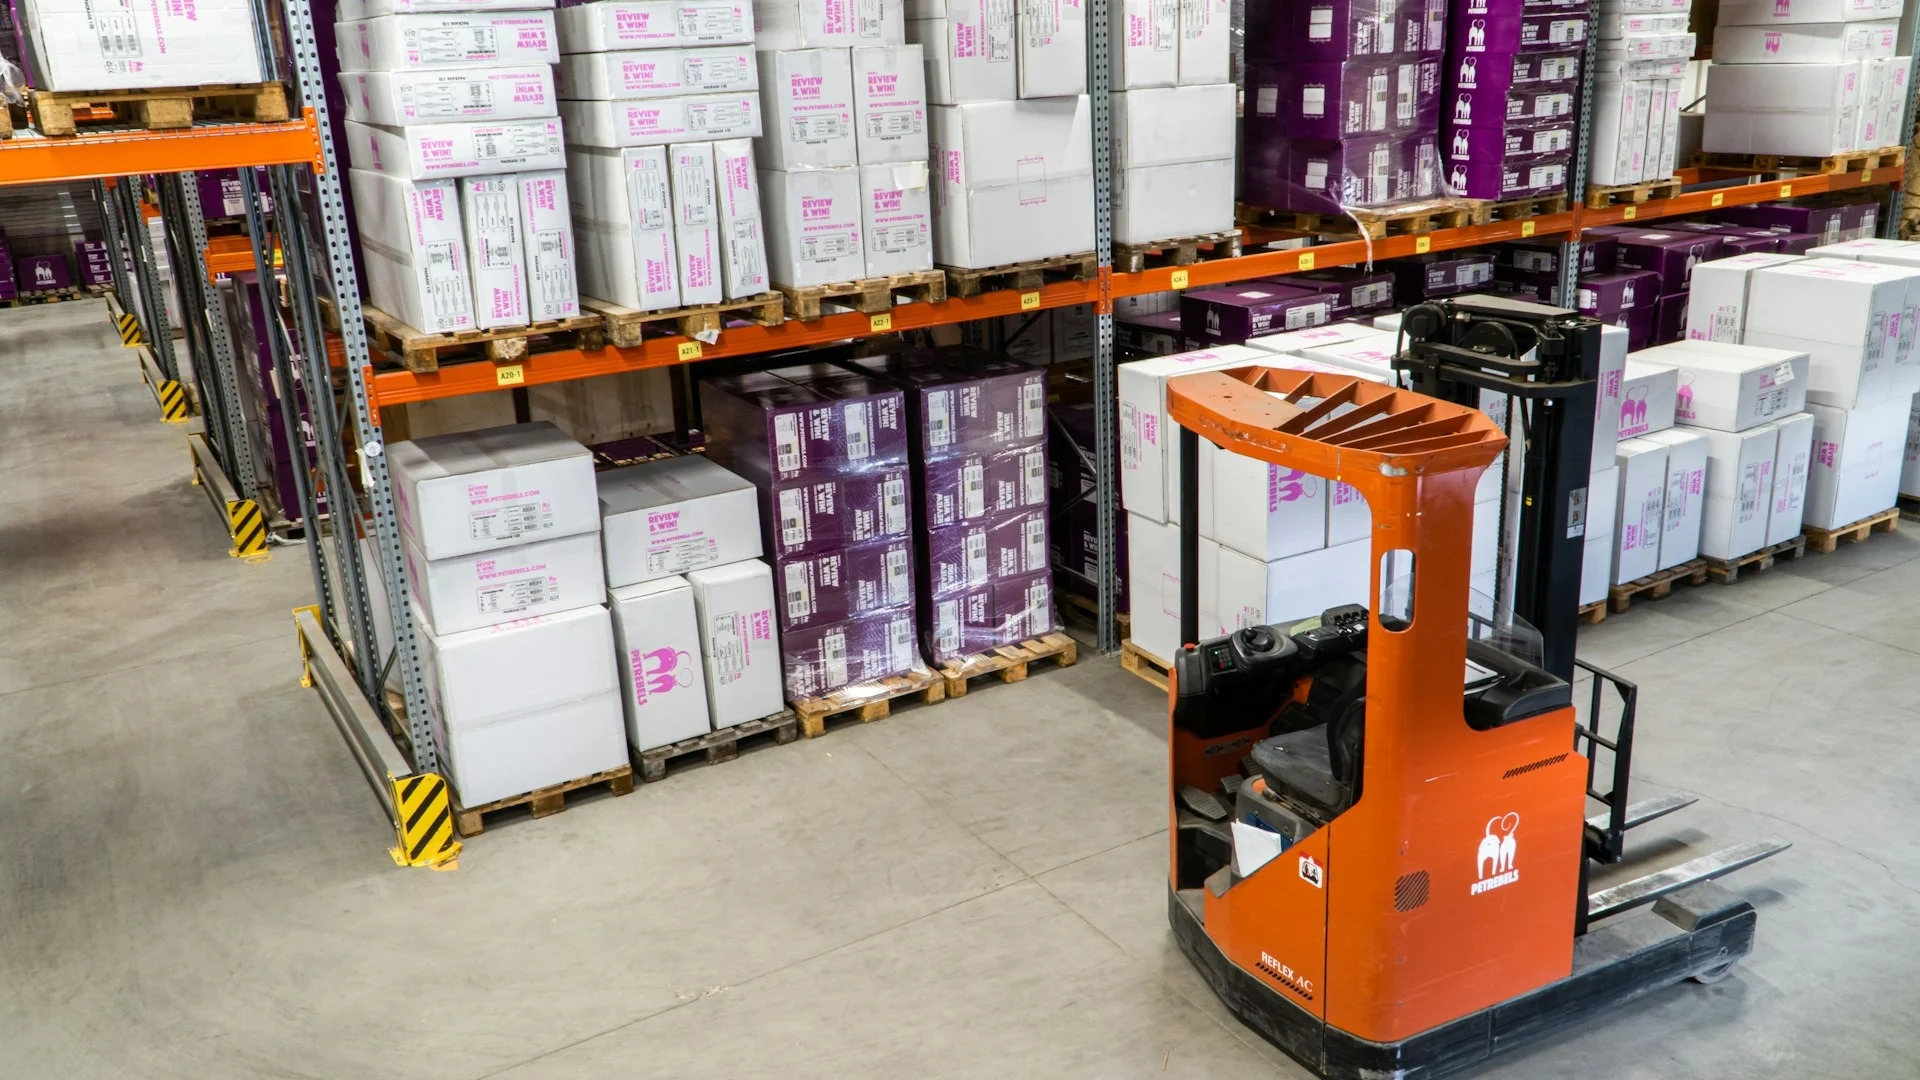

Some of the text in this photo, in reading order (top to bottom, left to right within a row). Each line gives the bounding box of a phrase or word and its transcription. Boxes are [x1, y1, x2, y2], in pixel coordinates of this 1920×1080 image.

[616, 13, 649, 21] REVIEW
[626, 21, 646, 29] WIN!
[623, 64, 655, 72] REVIEW
[791, 77, 822, 87] REVIEW
[868, 74, 897, 85] REVIEW
[800, 87, 820, 95] WIN!
[869, 86, 874, 94] &
[628, 110, 660, 118] REVIEW
[637, 118, 657, 126] WIN!
[421, 140, 453, 149] REVIEW
[432, 149, 452, 157] WIN!
[740, 157, 749, 190] REVIEW
[545, 180, 555, 211] REVIEW
[874, 190, 903, 200] REVIEW
[433, 189, 444, 221] REVIEW
[802, 199, 832, 208] REVIEW
[811, 208, 829, 216] WIN!
[647, 260, 656, 293] REVIEW
[493, 288, 503, 318] REVIEW
[874, 319, 889, 327] A22-1
[682, 346, 699, 355] A21-1
[501, 371, 521, 379] A20-1
[970, 387, 978, 418] REVIEW
[889, 397, 897, 430] REVIEW
[821, 408, 830, 441] REVIEW
[1827, 443, 1835, 468] REVIEW
[825, 483, 834, 515] REVIEW
[648, 511, 680, 524] REVIEW
[658, 521, 677, 530] WIN!
[830, 556, 839, 587] REVIEW
[761, 610, 770, 640] REVIEW
[630, 650, 647, 706] PETREBELS
[1471, 869, 1518, 895] PETREBELS
[1262, 951, 1313, 992] REFLEX AC
